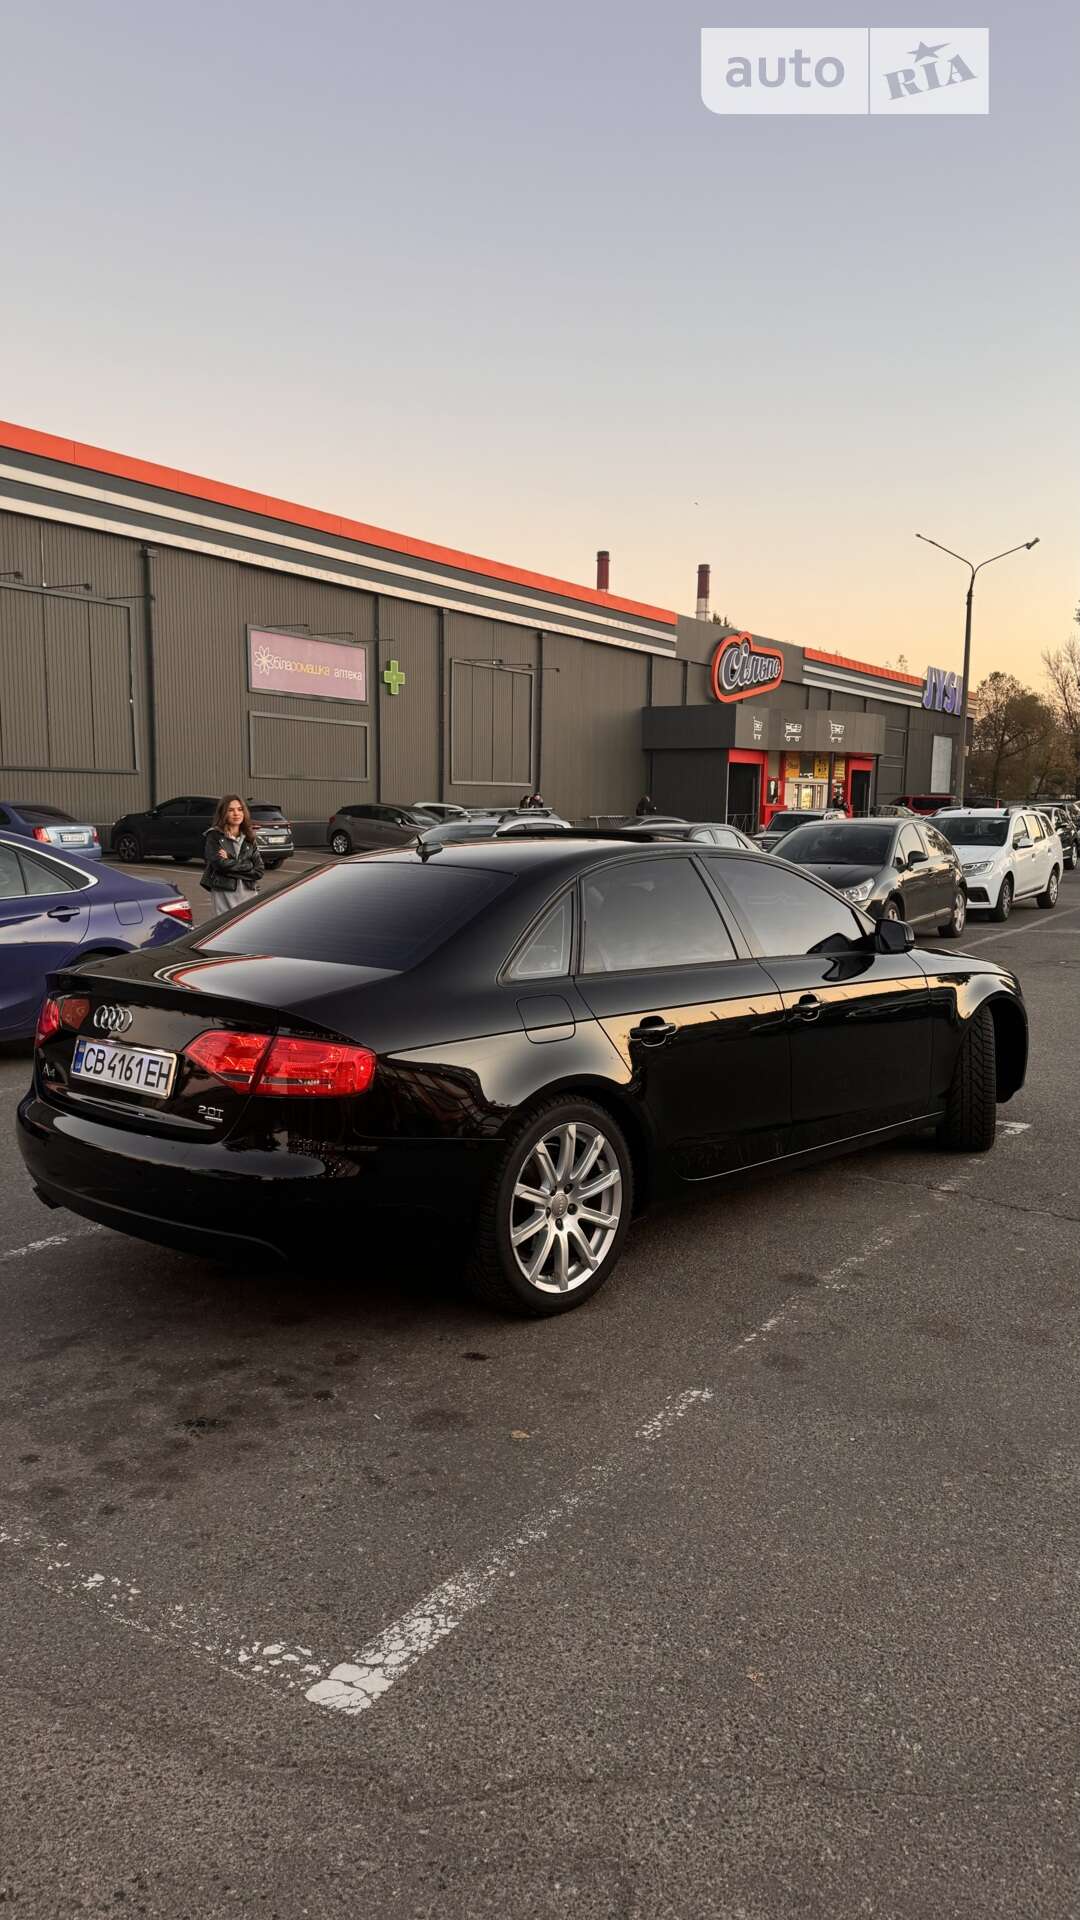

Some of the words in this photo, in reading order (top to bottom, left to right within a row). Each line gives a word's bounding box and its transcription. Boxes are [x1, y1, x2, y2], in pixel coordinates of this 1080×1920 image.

[334, 668, 362, 681] аптека
[84, 1048, 106, 1075] CB
[107, 1052, 144, 1084] 4161
[143, 1059, 172, 1090] EH
